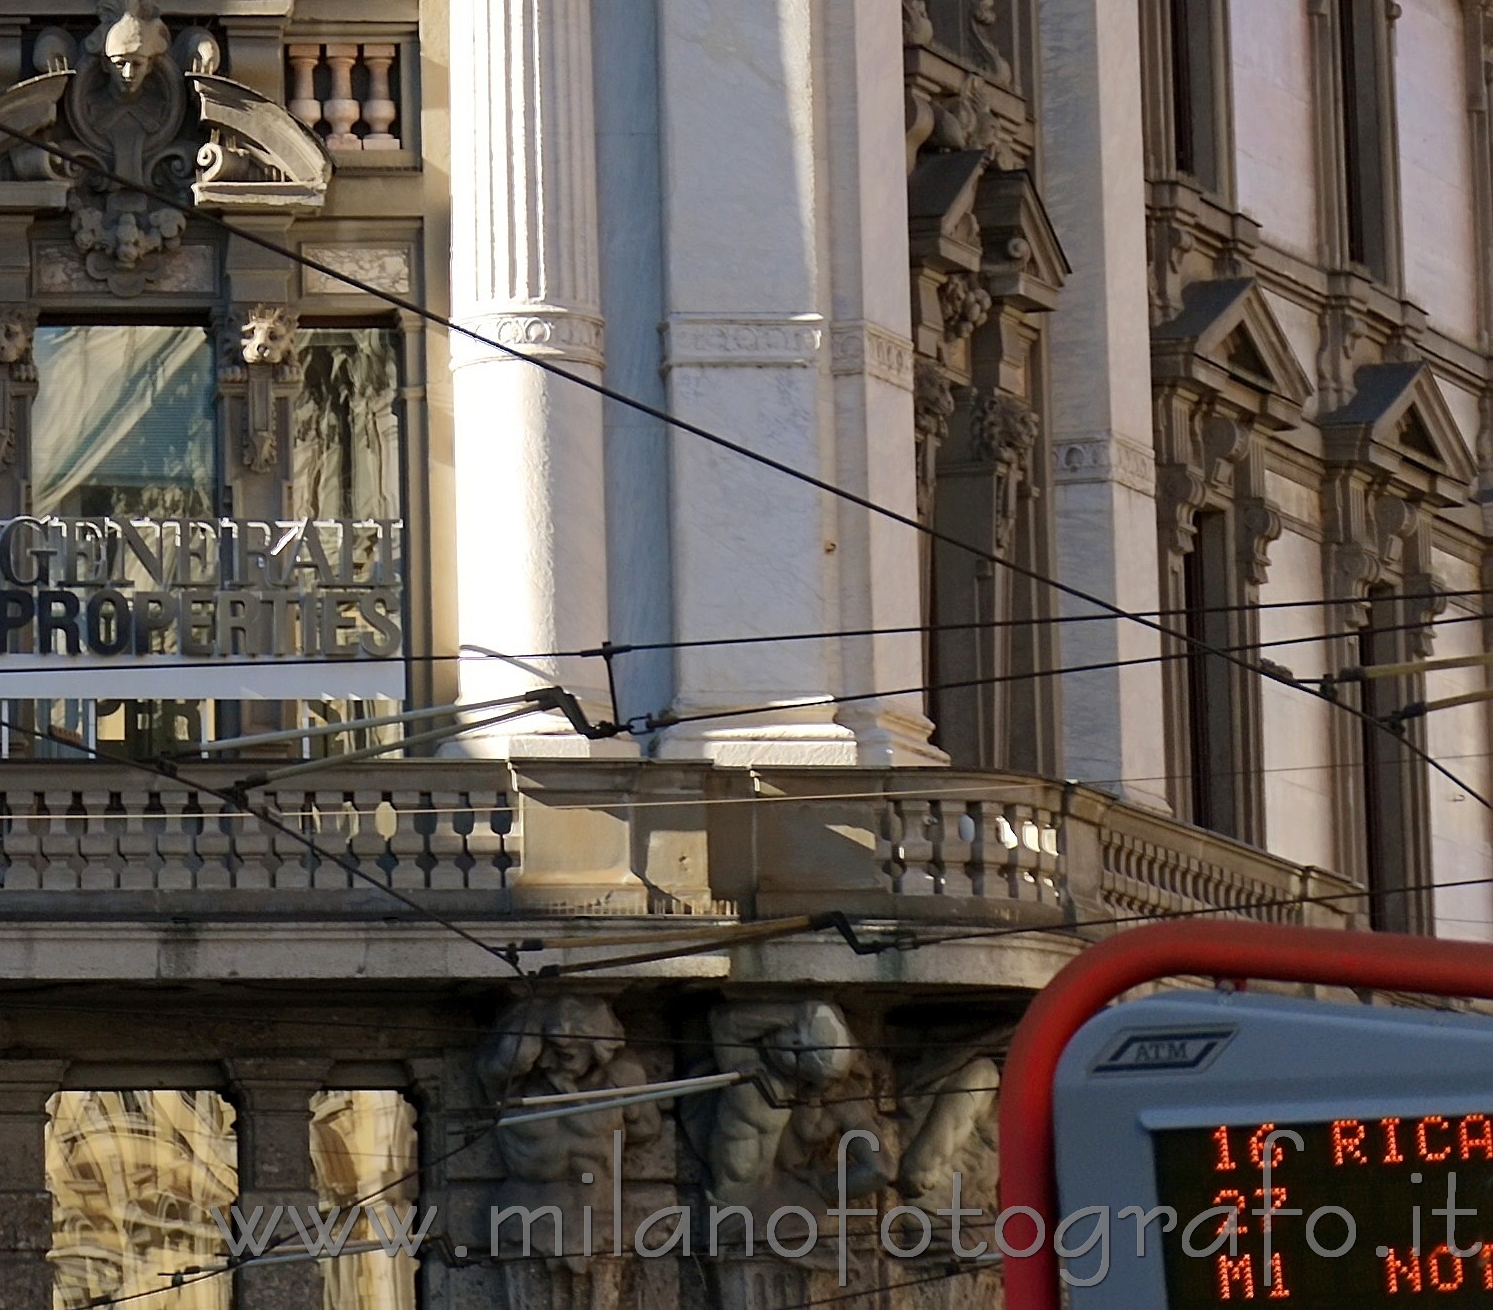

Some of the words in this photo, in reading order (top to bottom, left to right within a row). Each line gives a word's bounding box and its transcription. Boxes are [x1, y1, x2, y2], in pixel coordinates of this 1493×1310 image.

[1134, 1042, 1189, 1063] ATM
[1212, 1122, 1284, 1171] 16
[1331, 1113, 1493, 1166] RICA
[1212, 1187, 1287, 1236] 27
[1218, 1252, 1291, 1300] M1
